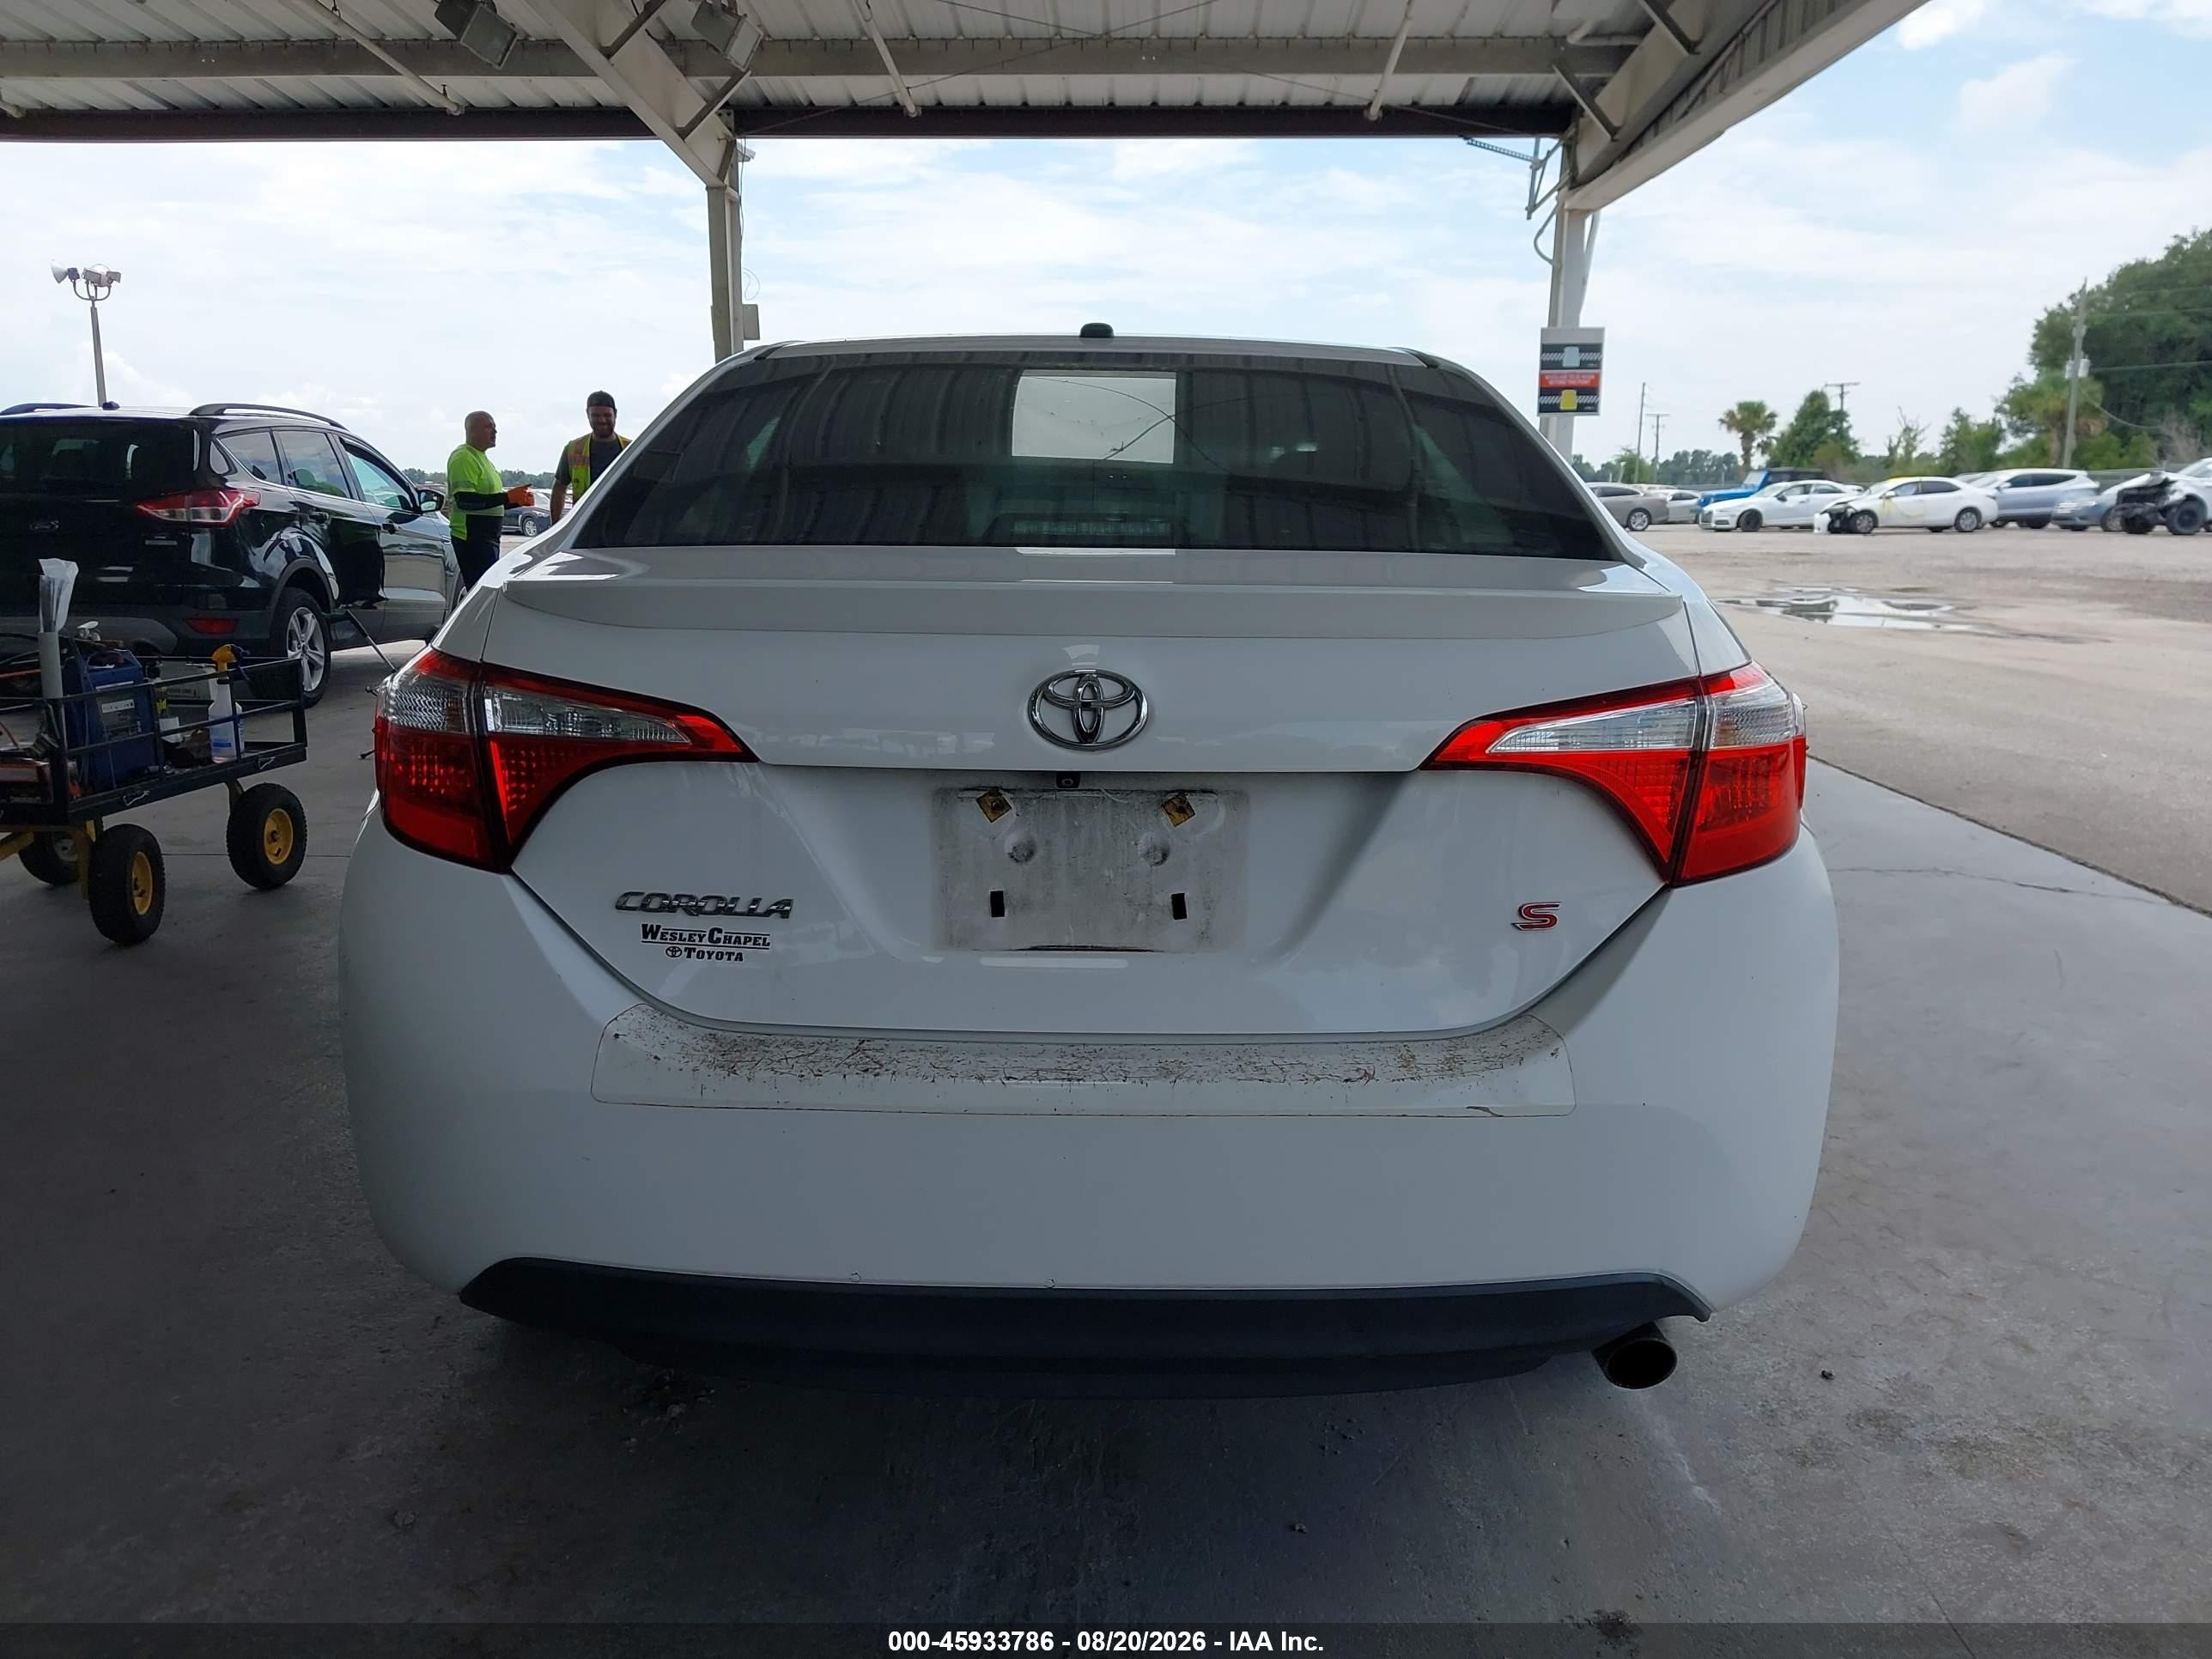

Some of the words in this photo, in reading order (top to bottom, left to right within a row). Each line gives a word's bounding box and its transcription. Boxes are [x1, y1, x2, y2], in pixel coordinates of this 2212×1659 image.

[615, 890, 794, 919] COROLLA
[1511, 901, 1561, 931] S
[641, 923, 707, 943] WESLEY
[708, 927, 770, 946] CHAPEL
[684, 946, 744, 962] TOYOTA
